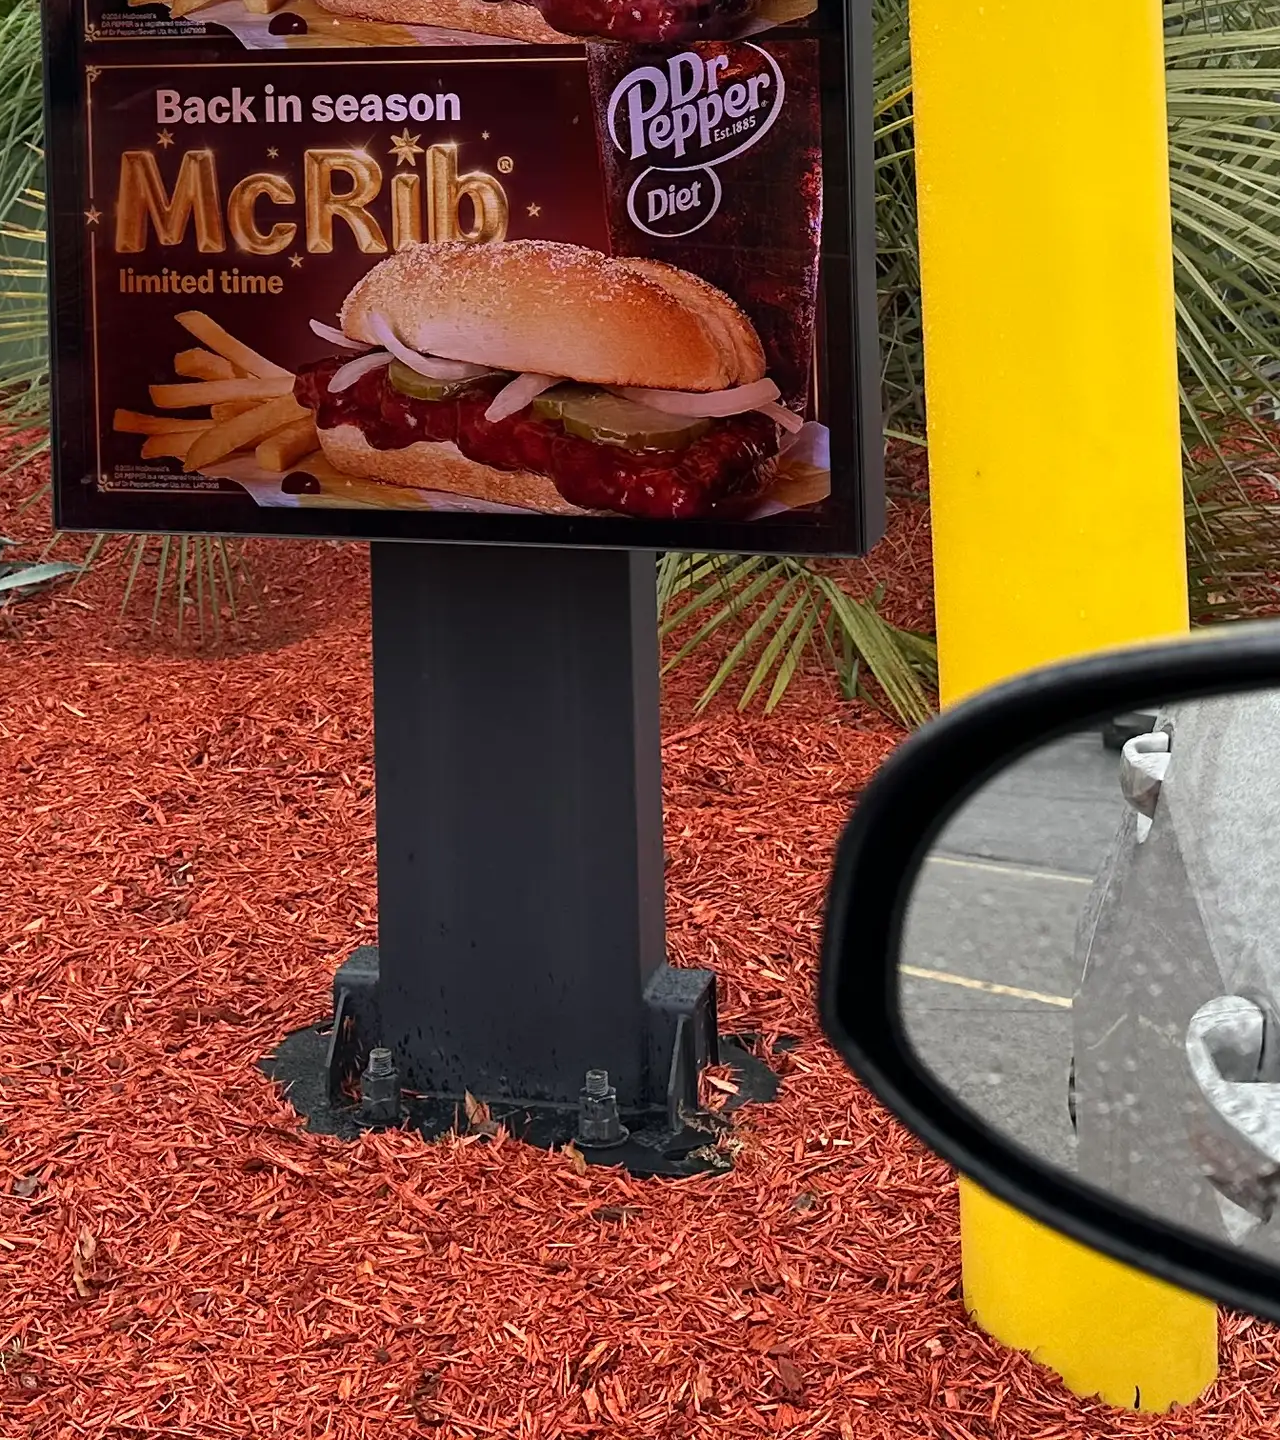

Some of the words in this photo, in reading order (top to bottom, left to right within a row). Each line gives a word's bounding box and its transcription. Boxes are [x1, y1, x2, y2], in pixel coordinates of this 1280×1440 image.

[667, 51, 729, 108] Dr
[156, 87, 256, 124] Back
[265, 84, 302, 123] in
[311, 90, 461, 123] season
[607, 65, 771, 160] Pepper
[647, 180, 701, 223] Diet
[119, 268, 214, 294] limited
[221, 267, 283, 294] time
